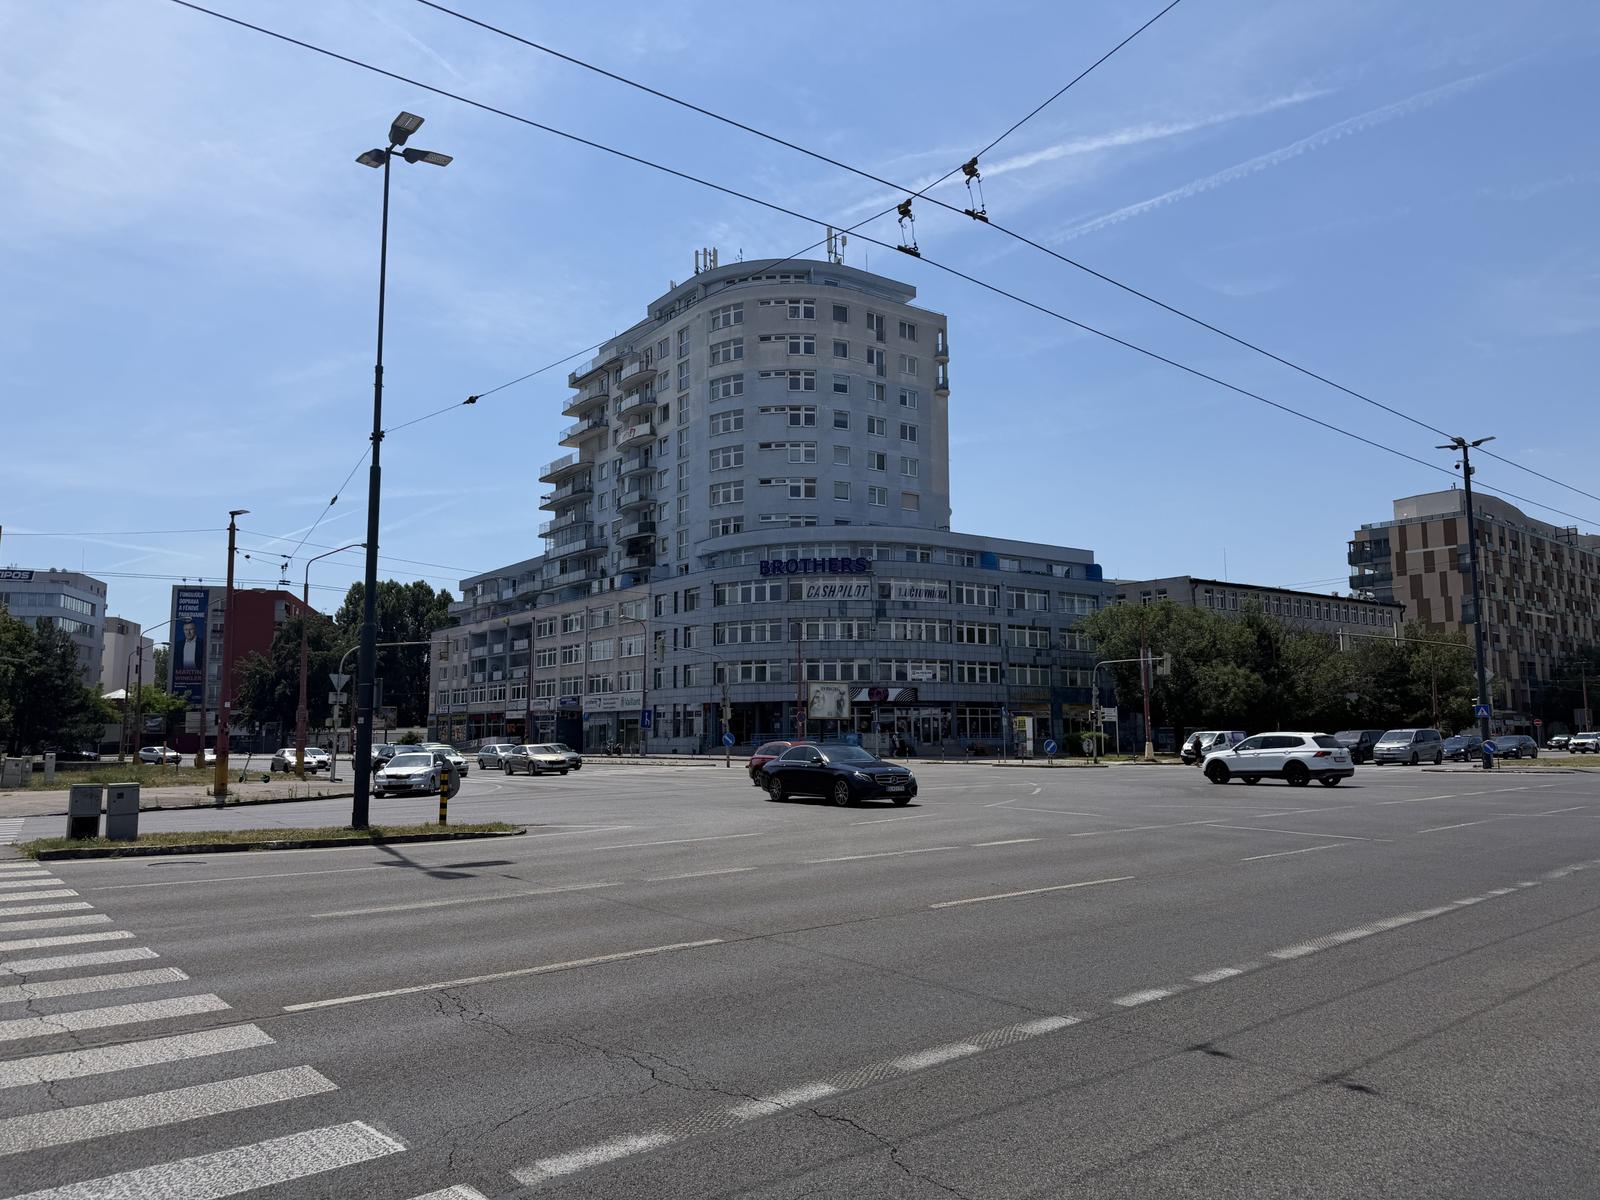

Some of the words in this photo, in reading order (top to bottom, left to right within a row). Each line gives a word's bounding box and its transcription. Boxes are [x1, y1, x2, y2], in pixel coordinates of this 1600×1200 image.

[760, 557, 868, 575] BROTHERS
[0, 571, 30, 579] IPOS
[807, 584, 869, 598] CASHPILOT
